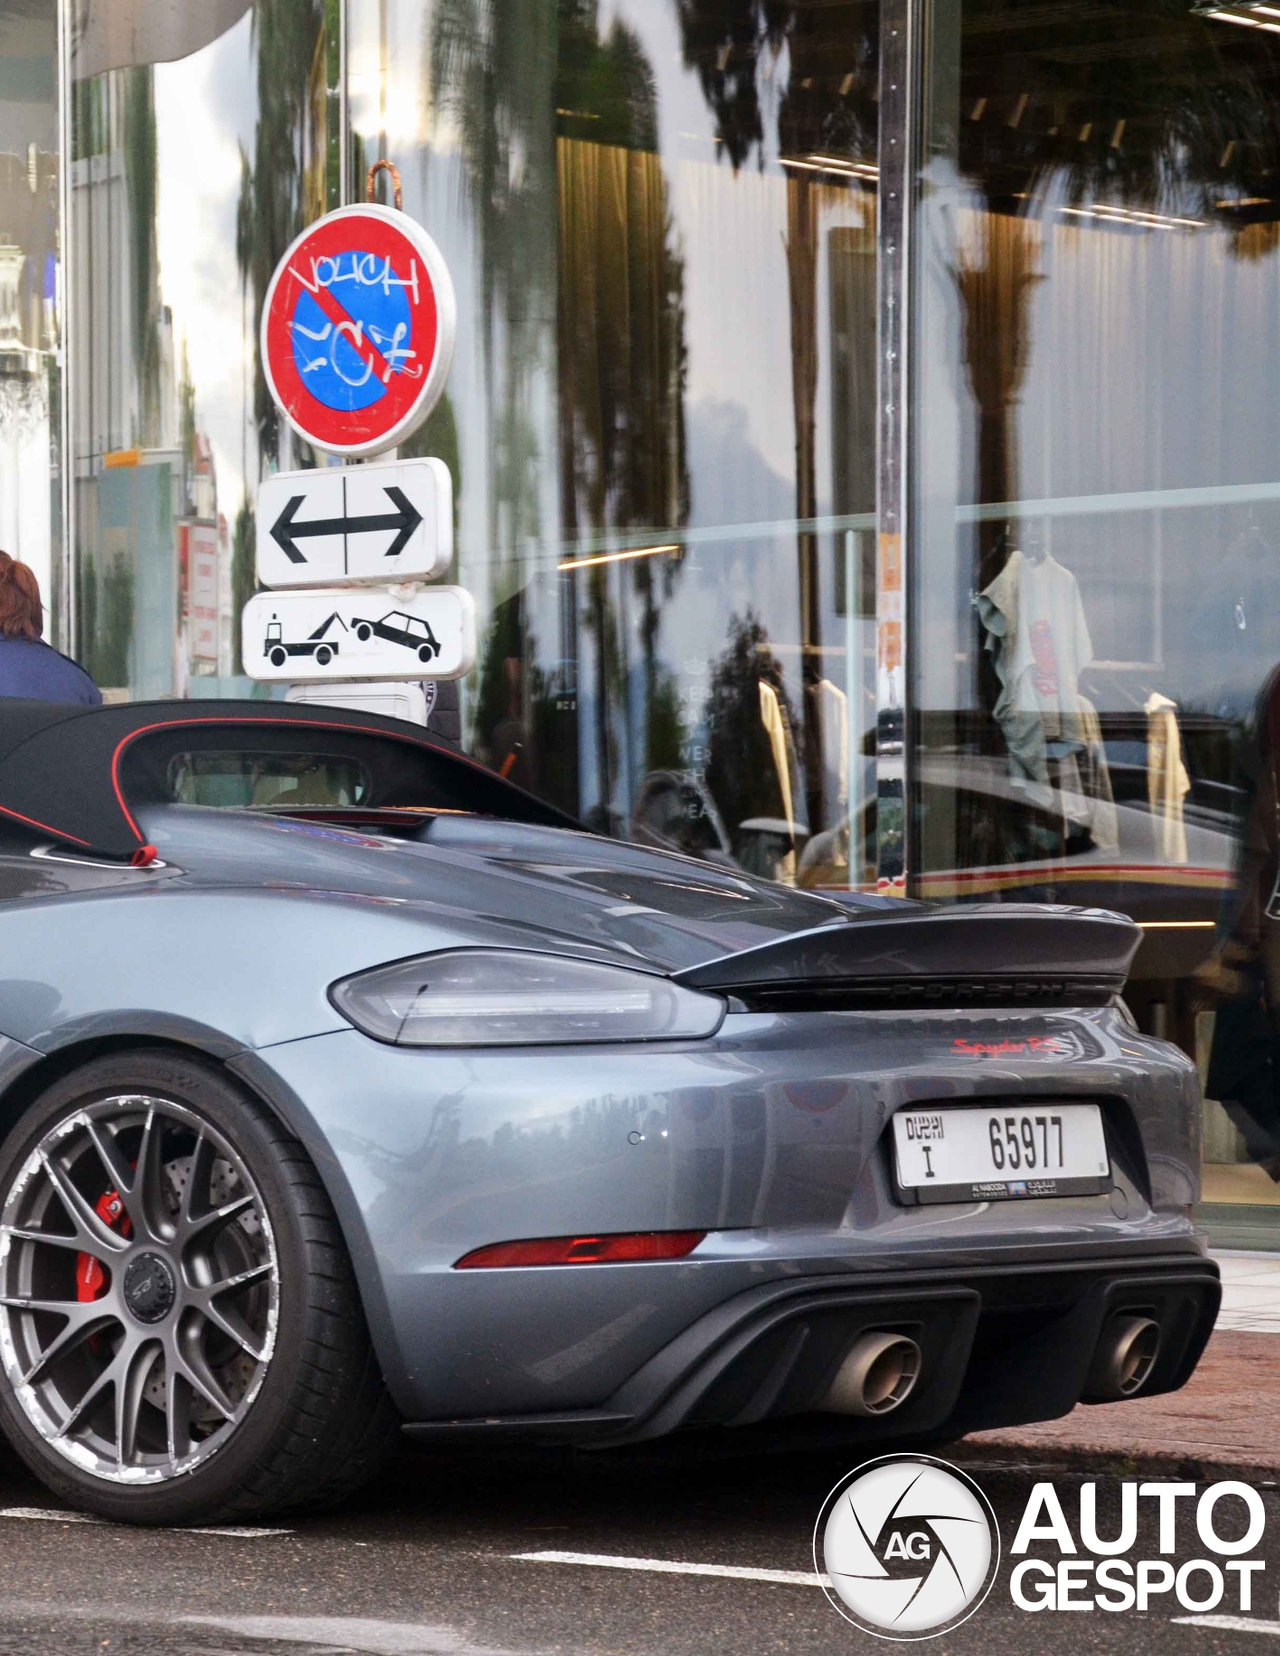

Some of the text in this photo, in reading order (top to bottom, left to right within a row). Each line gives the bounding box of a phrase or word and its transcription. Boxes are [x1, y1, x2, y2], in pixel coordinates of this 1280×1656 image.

[950, 1035, 1061, 1059] Spyder RS
[988, 1115, 1064, 1170] 65977
[922, 1145, 936, 1178] I
